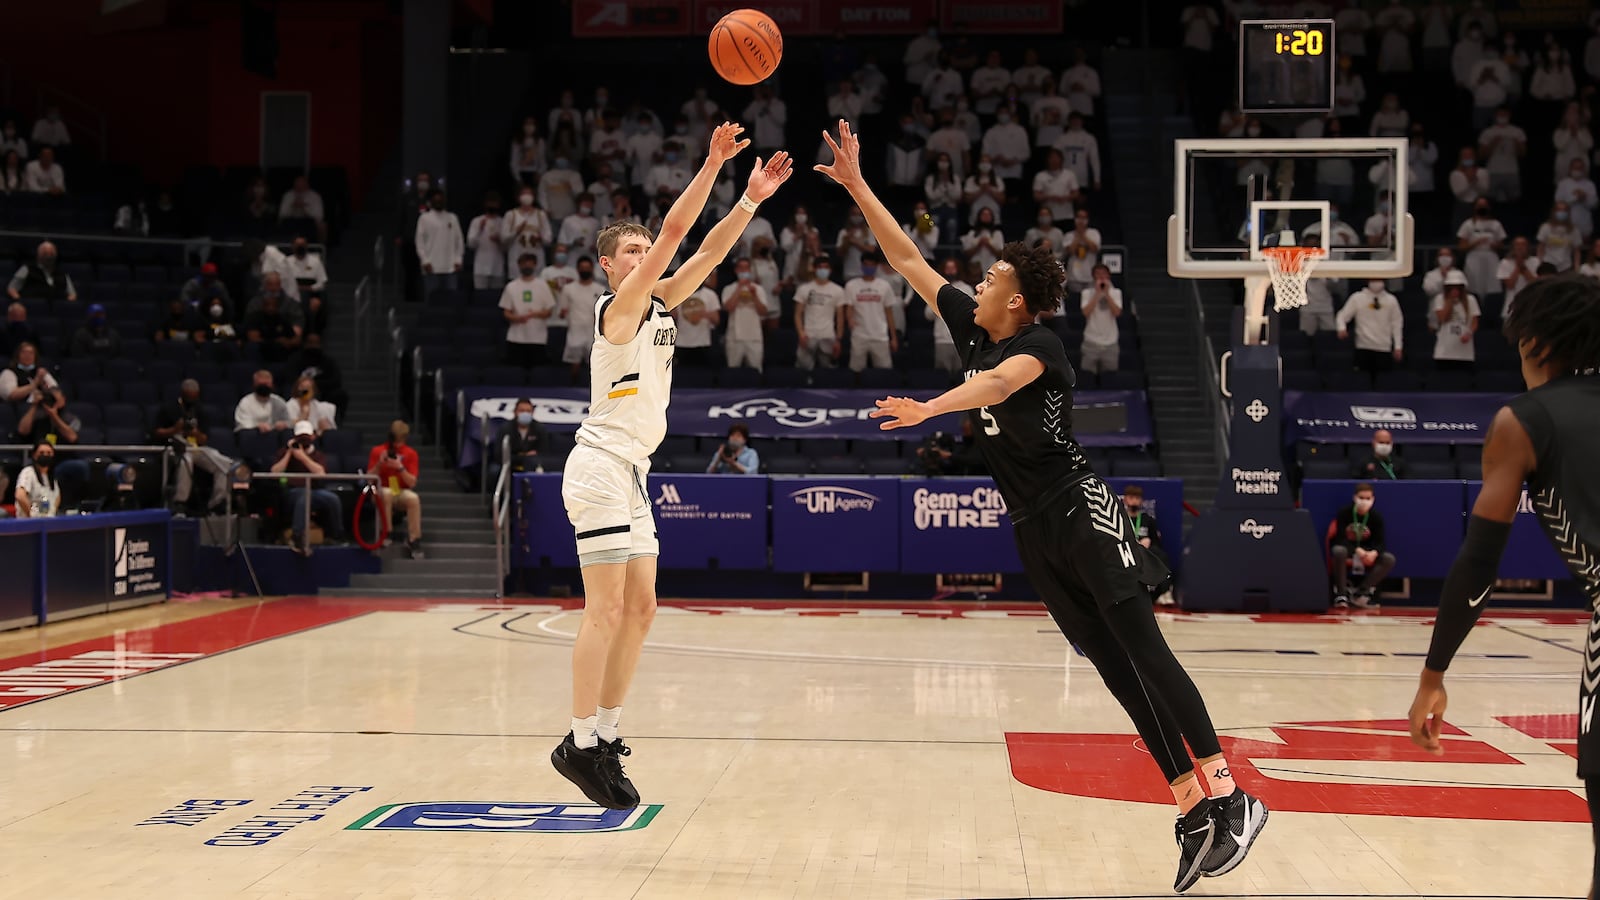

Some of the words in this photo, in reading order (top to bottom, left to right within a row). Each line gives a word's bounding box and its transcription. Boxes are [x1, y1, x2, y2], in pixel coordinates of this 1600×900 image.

[1275, 29, 1324, 56] 1:20
[980, 406, 1001, 437] 5
[1422, 421, 1479, 431] BANK
[1231, 467, 1281, 481] Premier
[1235, 480, 1279, 494] Health
[835, 496, 875, 512] Agency
[913, 487, 958, 516] Gem
[929, 509, 1000, 528] TIRE
[1239, 518, 1274, 539] Kroger
[1116, 541, 1137, 568] W
[269, 785, 374, 810] FIFTH
[135, 799, 253, 826] BANK
[203, 814, 325, 846] THIRD
